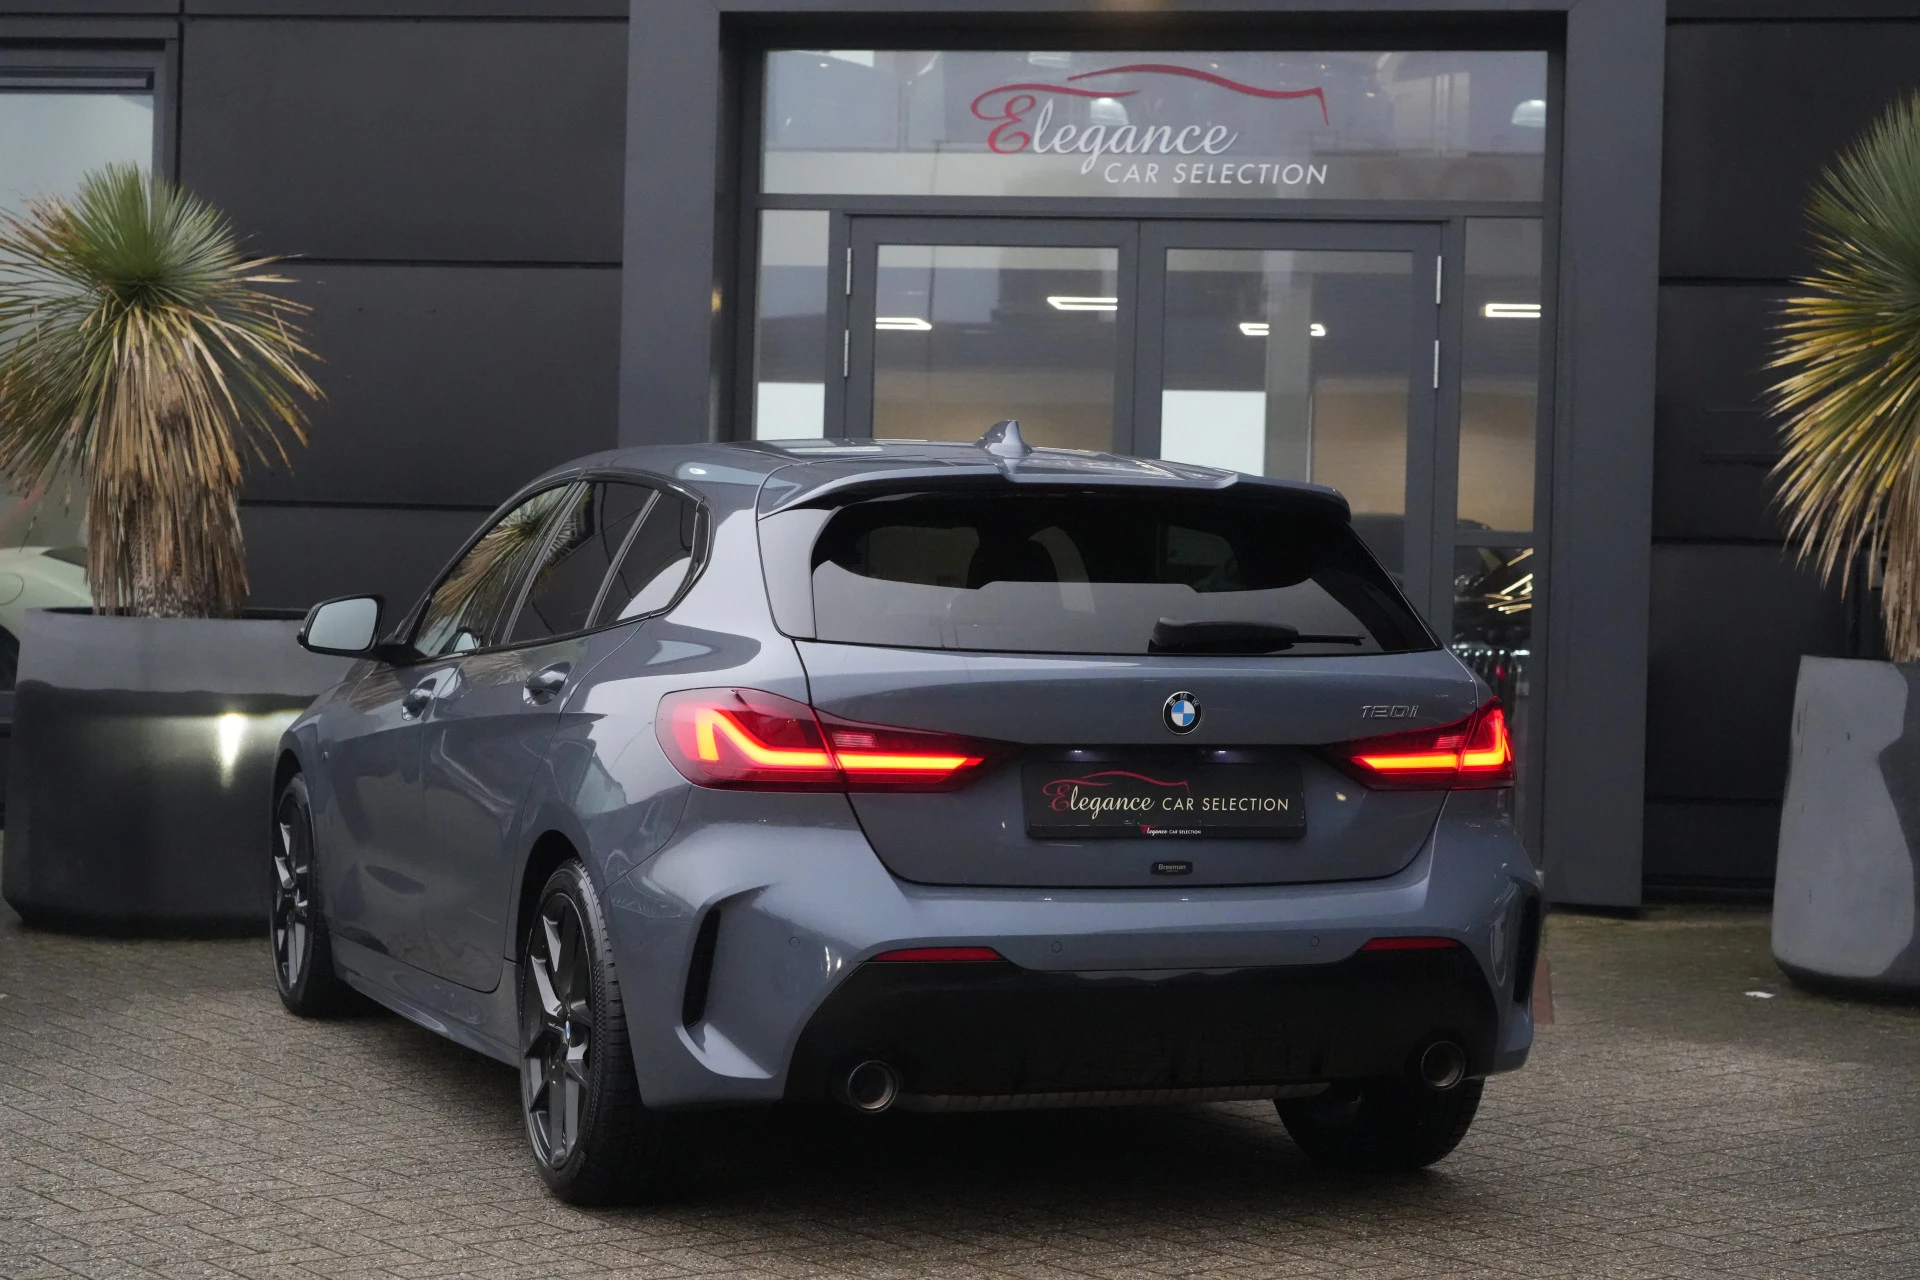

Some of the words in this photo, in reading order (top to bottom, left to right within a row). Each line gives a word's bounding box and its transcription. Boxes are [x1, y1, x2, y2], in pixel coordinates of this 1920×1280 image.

[971, 92, 1239, 175] Elegance
[1104, 162, 1159, 184] CAR
[1172, 163, 1328, 185] SELECTION
[1167, 692, 1200, 706] BMW
[1362, 704, 1419, 719] 120i
[1043, 784, 1155, 820] Elegance
[1162, 797, 1194, 811] CAR
[1202, 797, 1289, 812] SELECTION
